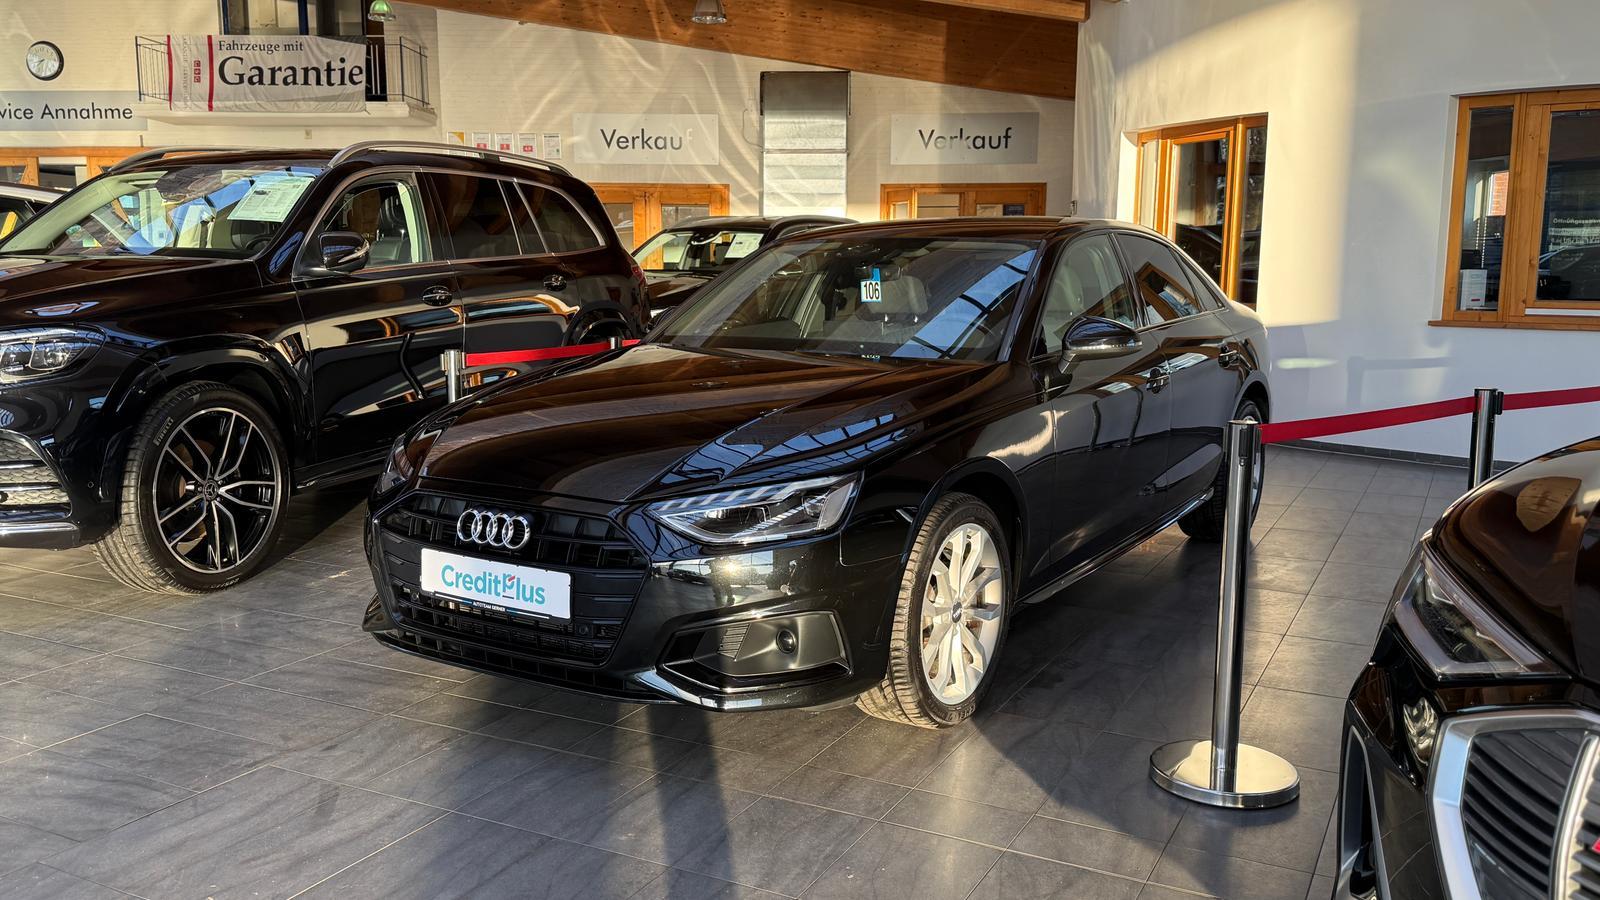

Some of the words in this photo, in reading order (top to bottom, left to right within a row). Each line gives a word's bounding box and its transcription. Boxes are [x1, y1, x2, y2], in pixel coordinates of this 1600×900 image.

[218, 39, 279, 54] Fahrzeuge
[284, 40, 303, 52] mit
[218, 56, 364, 87] Garantie
[40, 102, 133, 120] Annahme
[918, 127, 1012, 150] Verkauf
[863, 282, 880, 300] 106
[441, 565, 546, 605] CreditPlus
